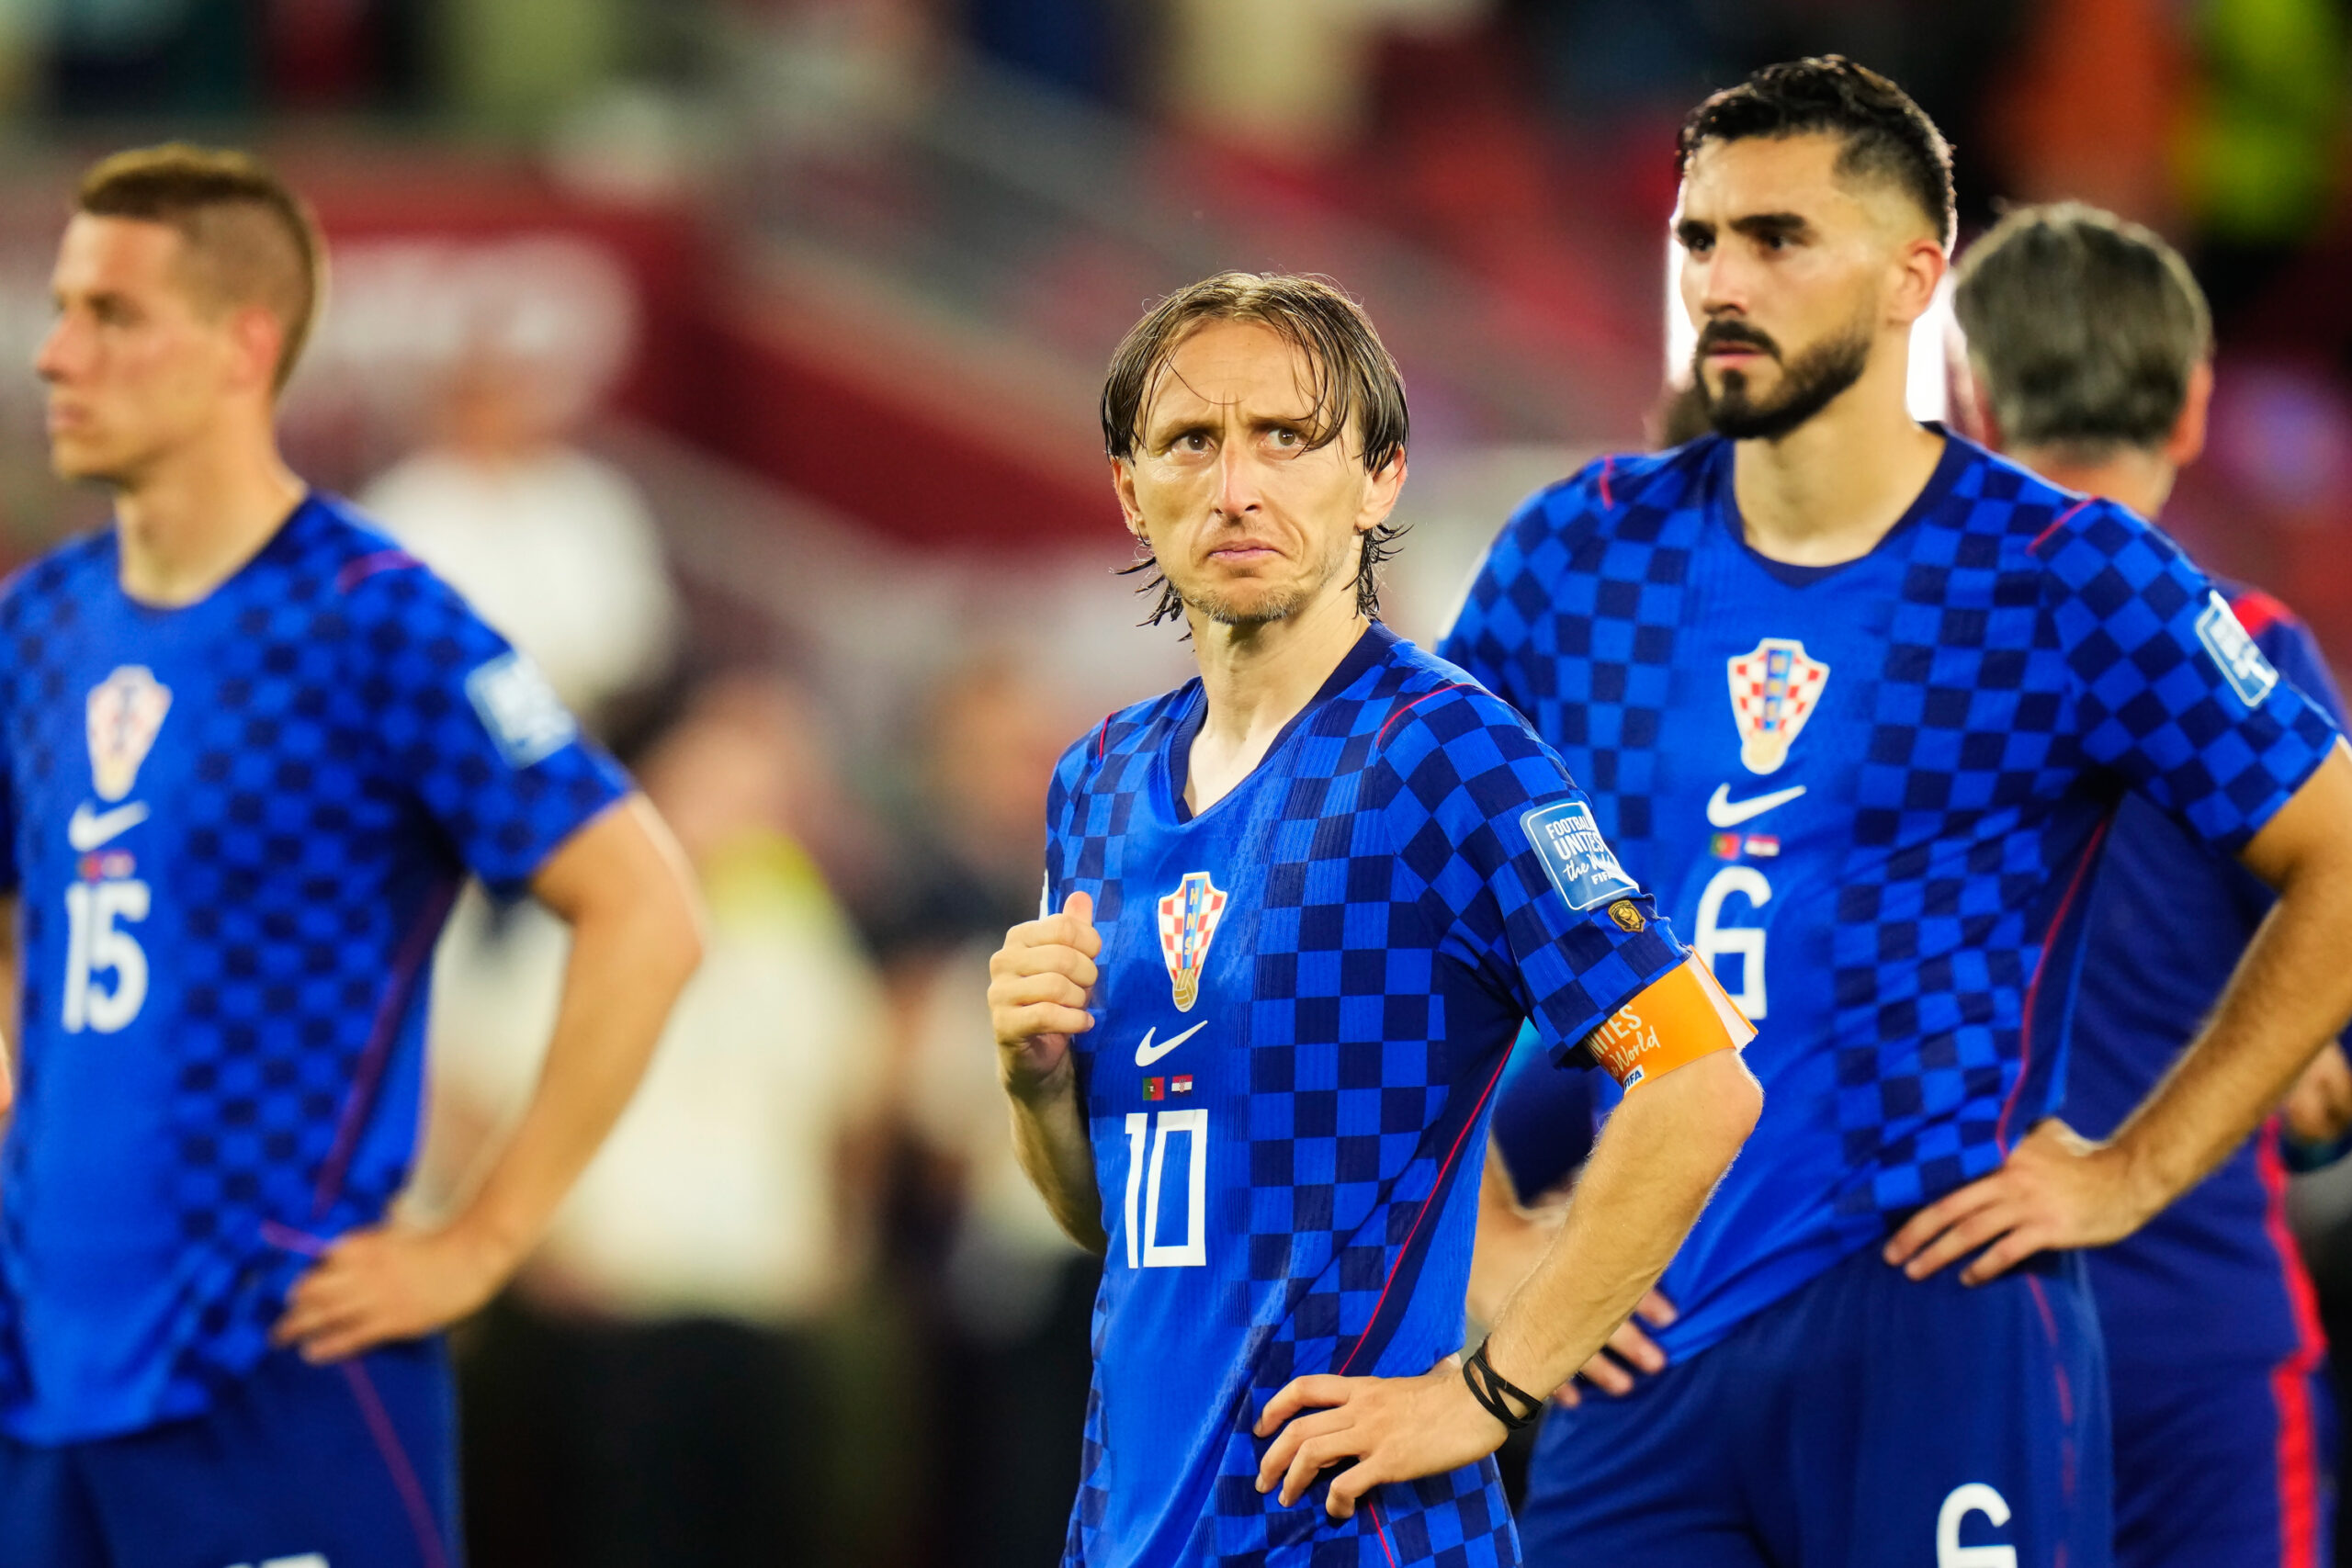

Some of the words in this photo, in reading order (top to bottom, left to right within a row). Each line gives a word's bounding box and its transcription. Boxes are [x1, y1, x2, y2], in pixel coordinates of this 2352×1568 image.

[1545, 815, 1595, 840] FOOTBAL
[1554, 830, 1605, 861] UNITES
[1563, 860, 1589, 882] the
[1591, 871, 1611, 886] FIF
[62, 880, 152, 1033] 15
[1694, 865, 1772, 1020] 6
[1589, 1004, 1643, 1061] NITES
[1609, 1024, 1661, 1073] World
[1623, 1070, 1643, 1091] FIFA
[1125, 1109, 1208, 1269] 10
